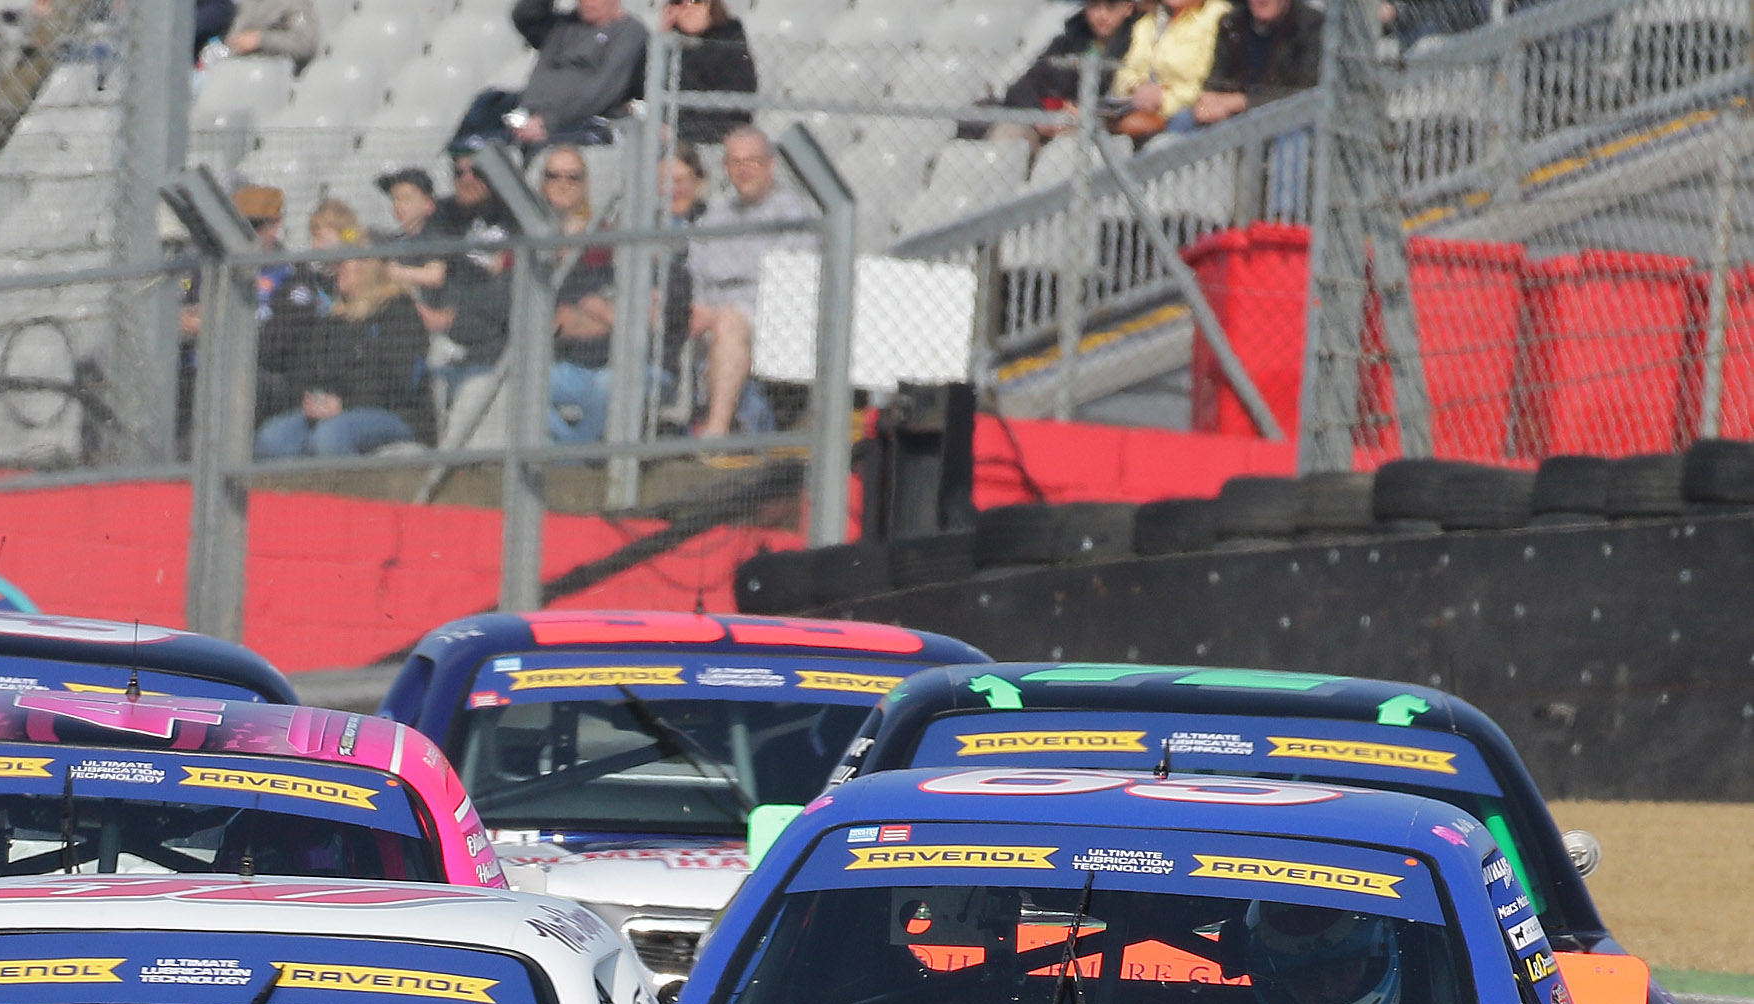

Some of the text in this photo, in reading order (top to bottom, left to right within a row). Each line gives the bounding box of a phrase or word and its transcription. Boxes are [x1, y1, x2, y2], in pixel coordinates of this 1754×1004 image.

[813, 676, 896, 691] RAVE
[974, 735, 1127, 750] RAVENOL
[1172, 732, 1241, 741] ULTIMATE
[1299, 743, 1440, 765] RAVENOL
[82, 760, 153, 769] ULTIMATE
[70, 766, 165, 776] LUBRICATION
[70, 772, 165, 784] TECHNOLOGY
[197, 770, 359, 800] RAVENOL
[867, 850, 1036, 864] RAVENOL
[1088, 848, 1163, 859] ULTIMATE
[1073, 855, 1174, 867] LUBRICATION
[1072, 862, 1174, 875] TECHNOLOGY
[1210, 861, 1381, 889] RAVENOL
[1497, 902, 1519, 920] Macs
[156, 959, 240, 968] ULTIMATE
[141, 967, 252, 976] LUBRICATION
[139, 975, 252, 985] TECHNOLOGY
[291, 968, 475, 995] RAVENOL
